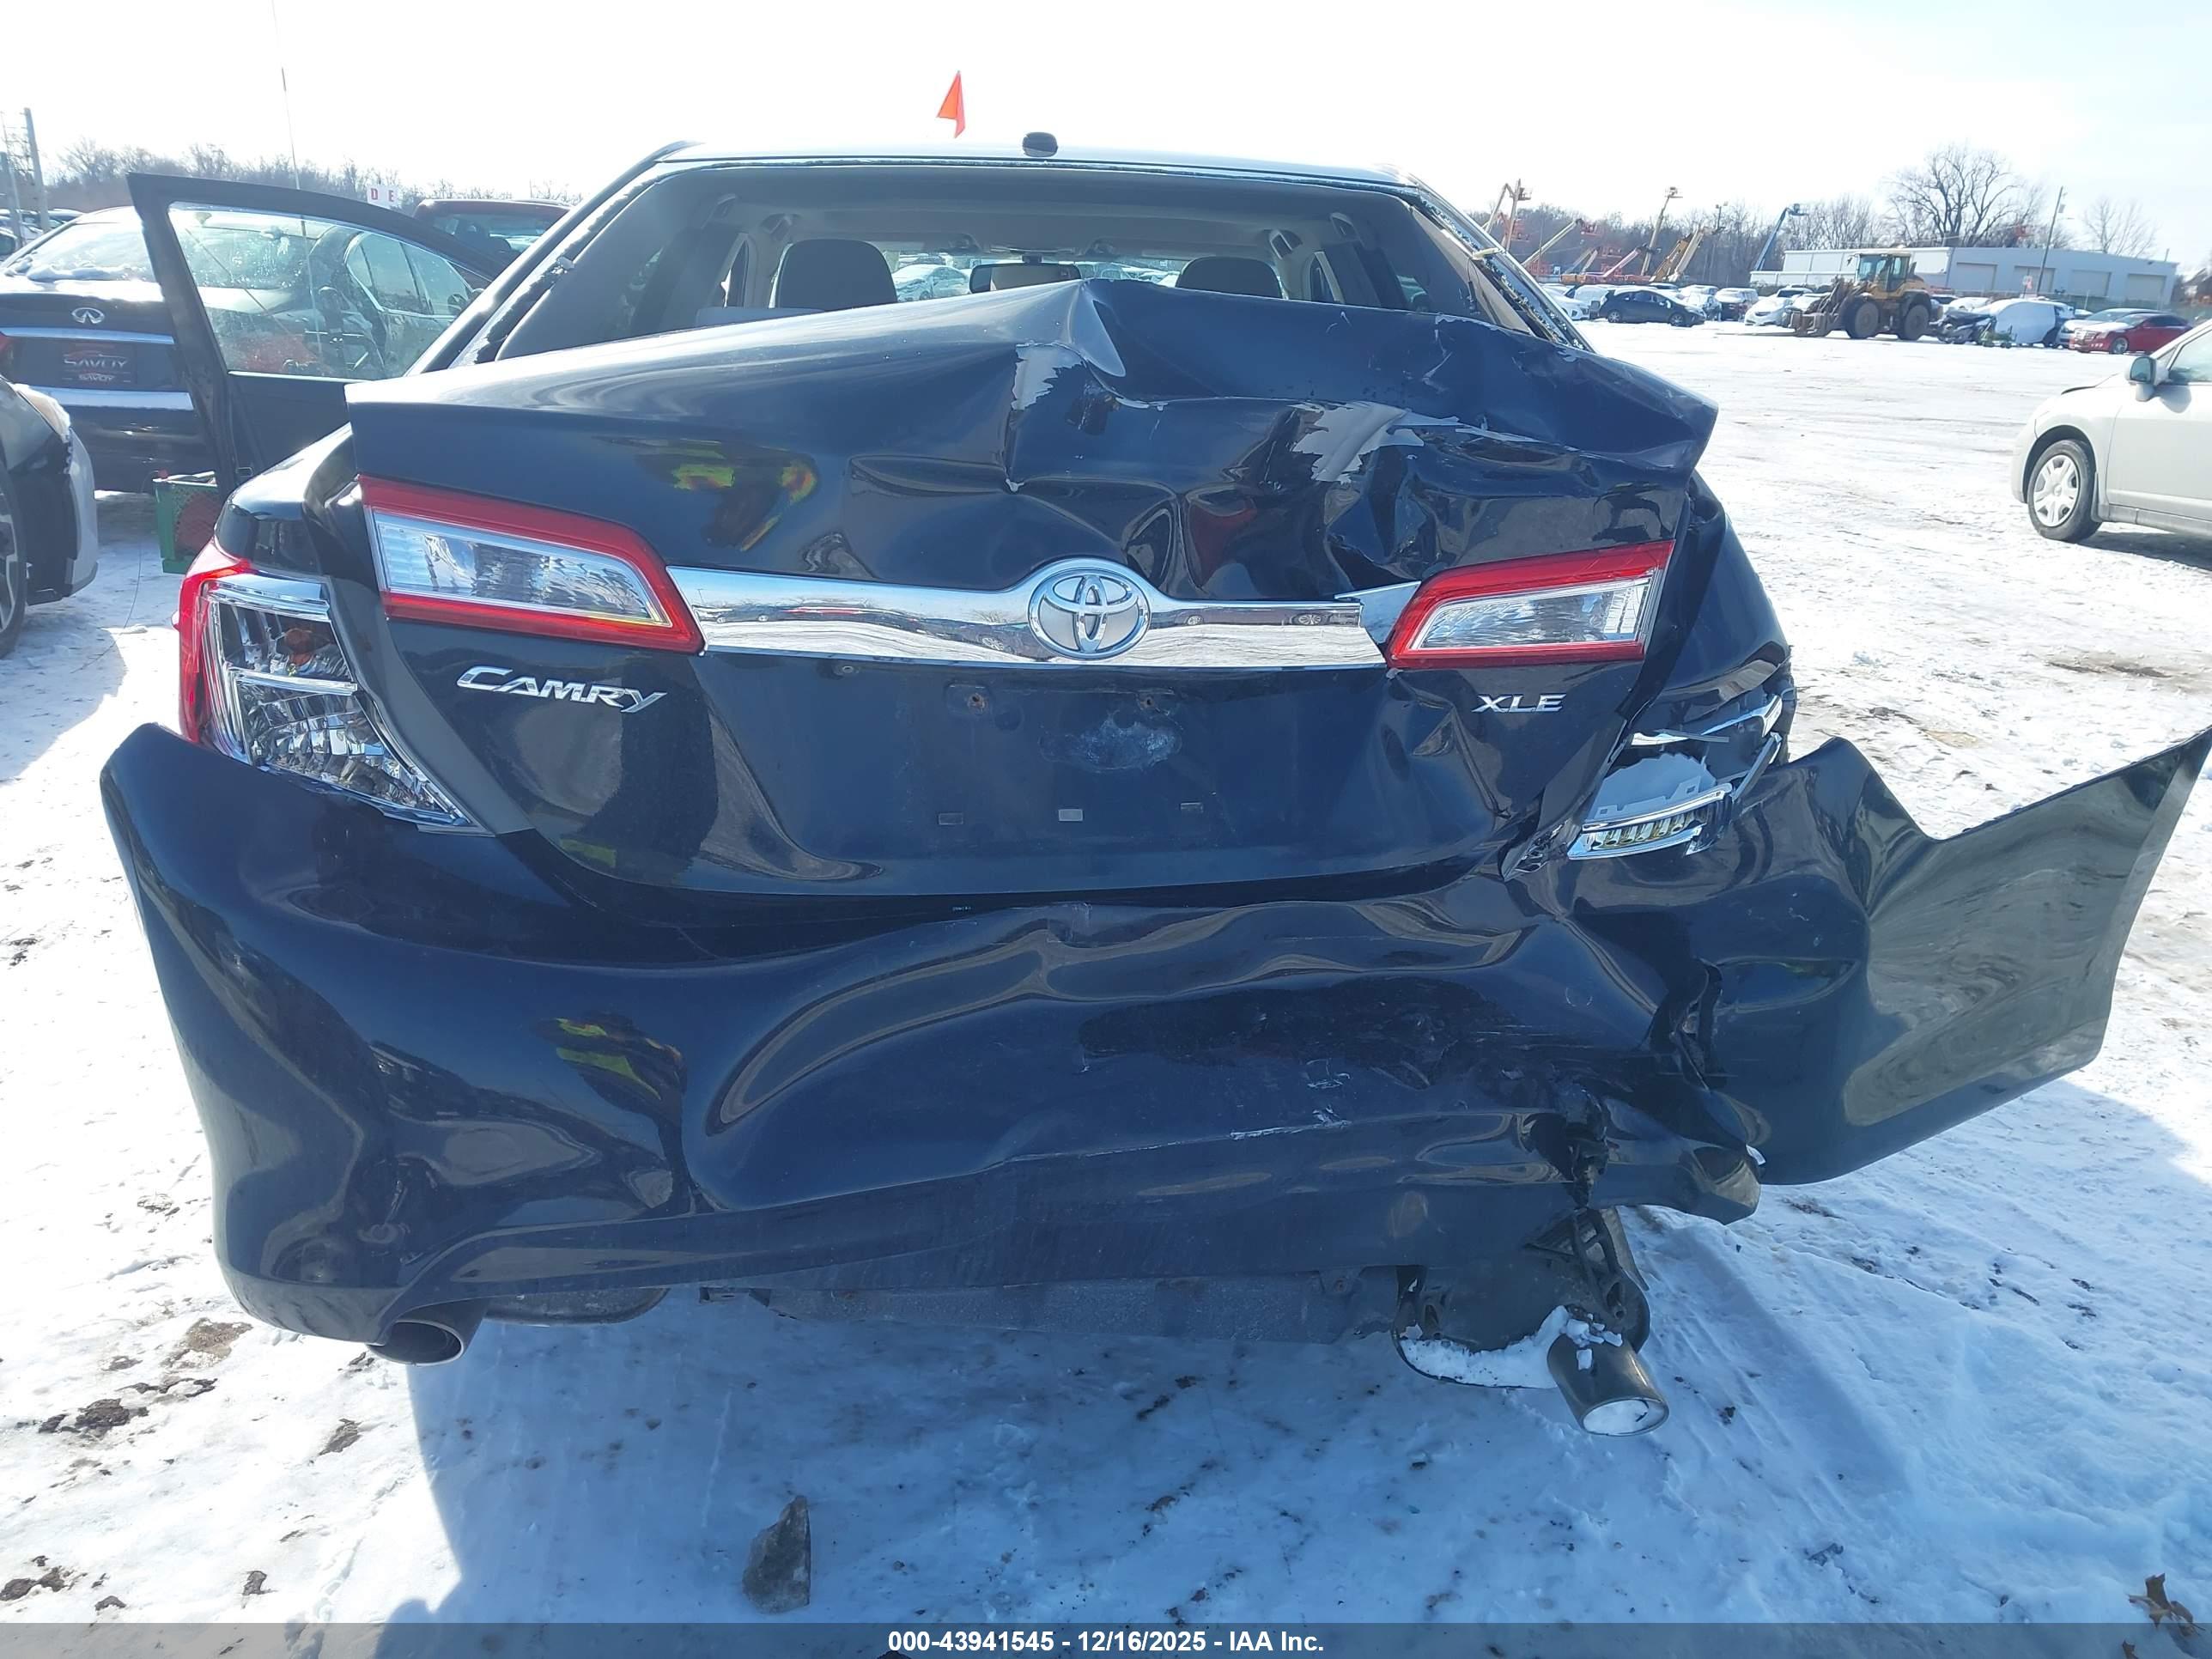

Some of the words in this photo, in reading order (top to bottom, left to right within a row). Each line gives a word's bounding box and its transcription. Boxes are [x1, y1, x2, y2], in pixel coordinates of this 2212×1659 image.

[371, 188, 378, 200] D
[388, 190, 394, 202] E
[457, 665, 667, 713] CAMRY
[1471, 694, 1566, 713] XLE
